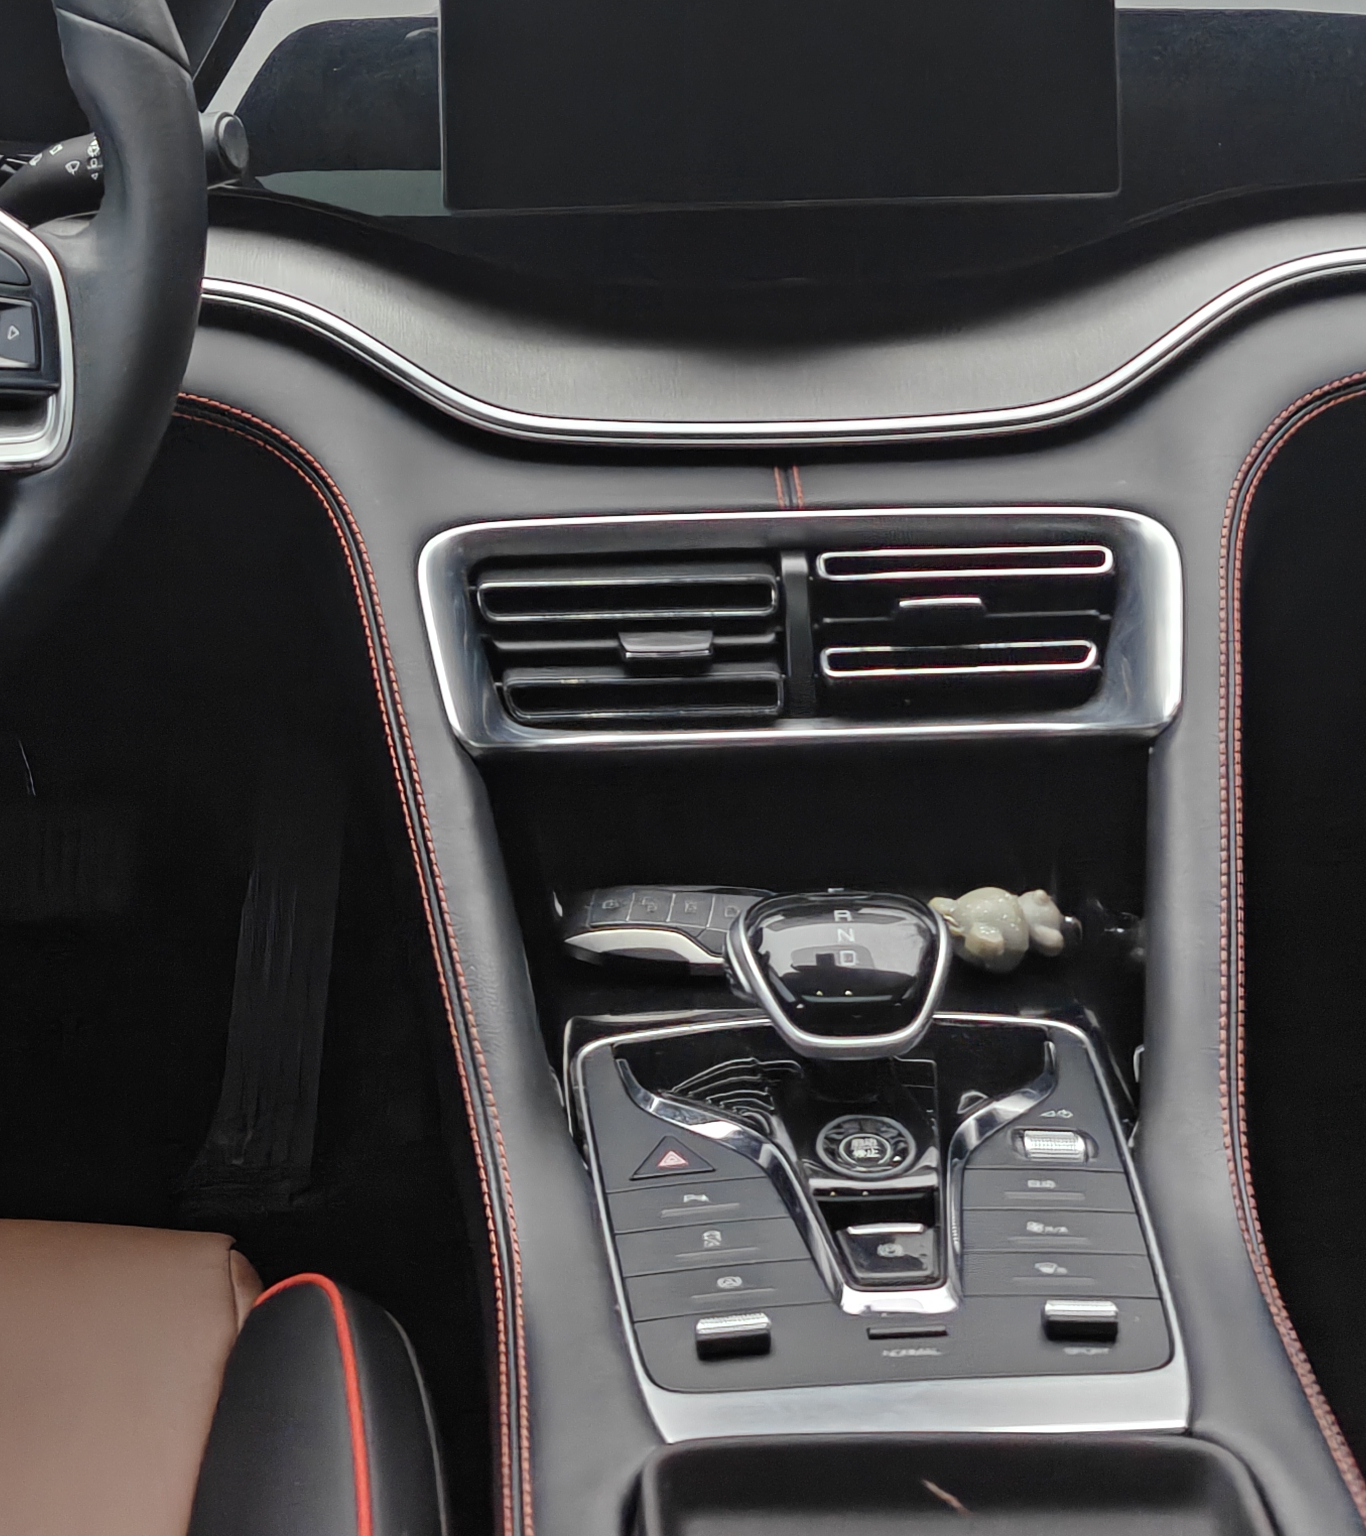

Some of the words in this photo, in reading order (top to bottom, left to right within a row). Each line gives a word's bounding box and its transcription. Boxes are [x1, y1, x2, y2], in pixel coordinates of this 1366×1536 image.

[833, 909, 853, 922] R
[837, 928, 855, 942] N
[839, 950, 857, 966] D
